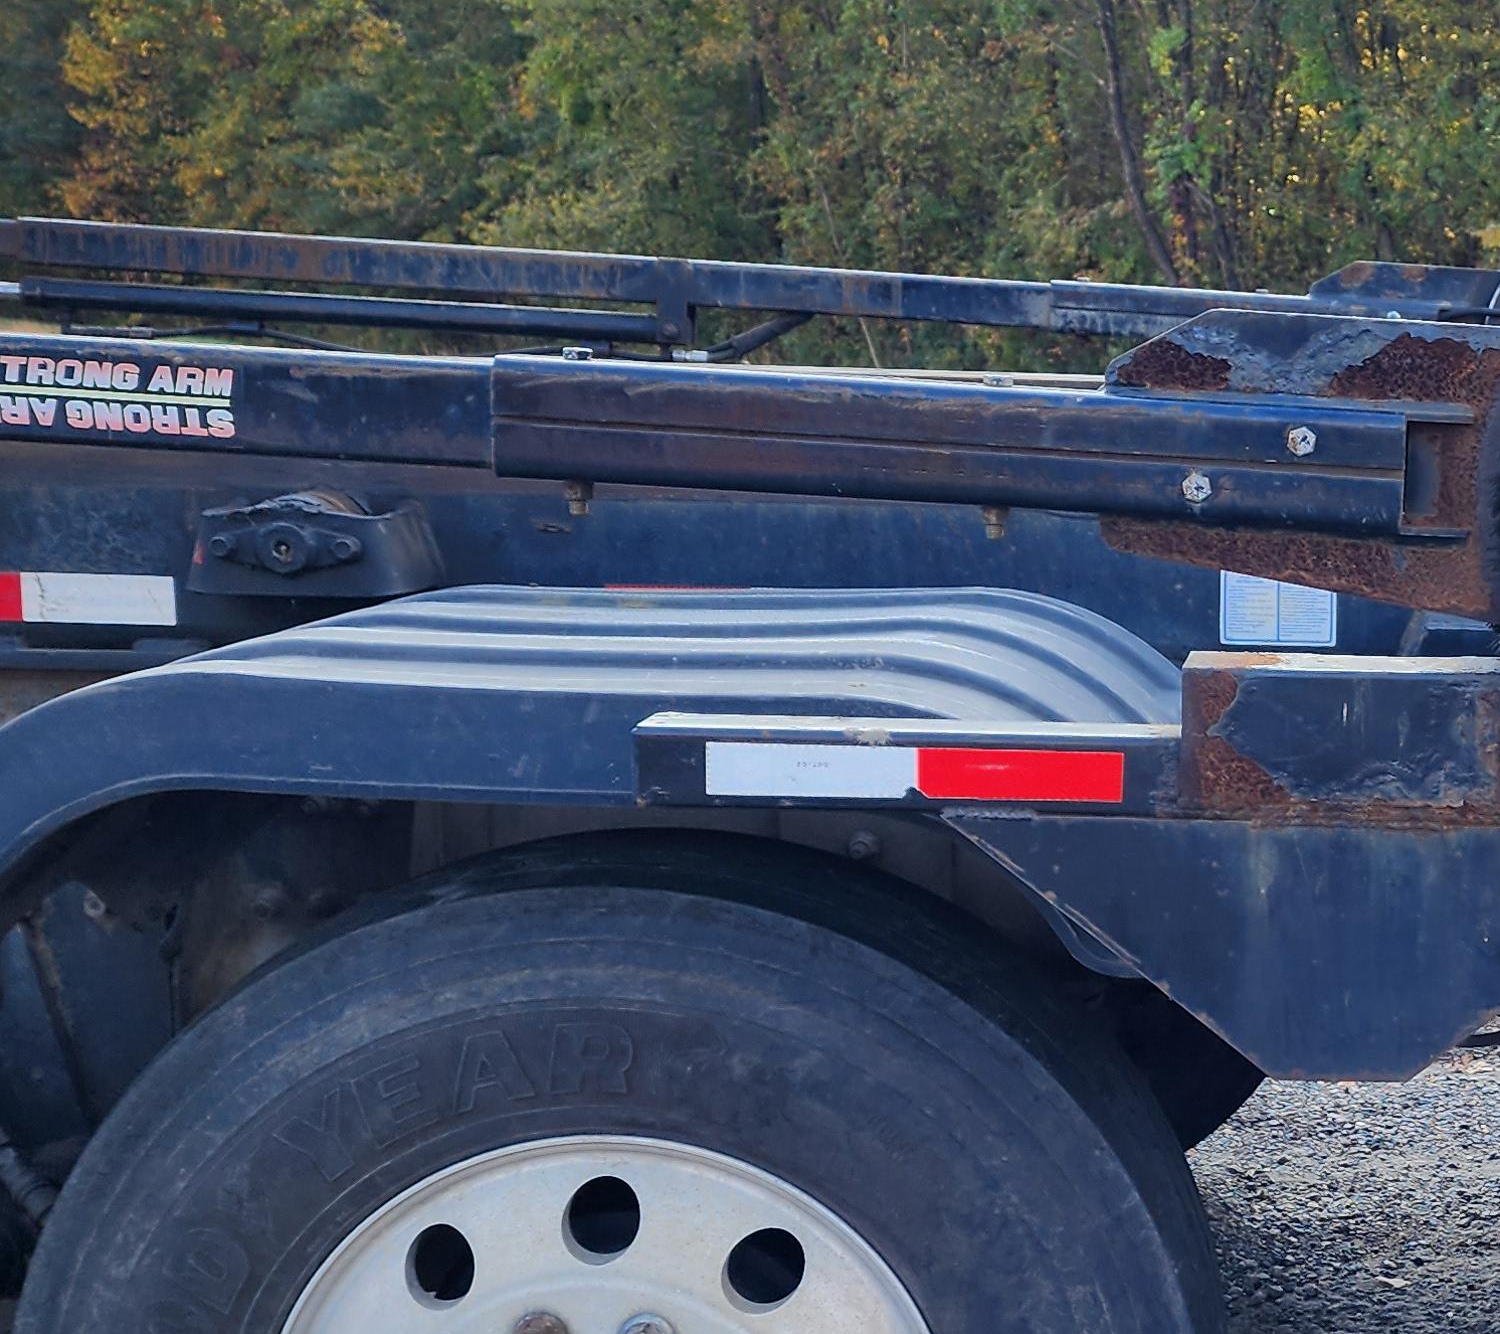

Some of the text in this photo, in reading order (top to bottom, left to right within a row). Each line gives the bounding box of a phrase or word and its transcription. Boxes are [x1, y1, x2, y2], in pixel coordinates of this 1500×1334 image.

[0, 355, 233, 396] TRONG ARM
[0, 395, 236, 439] STRONG AR
